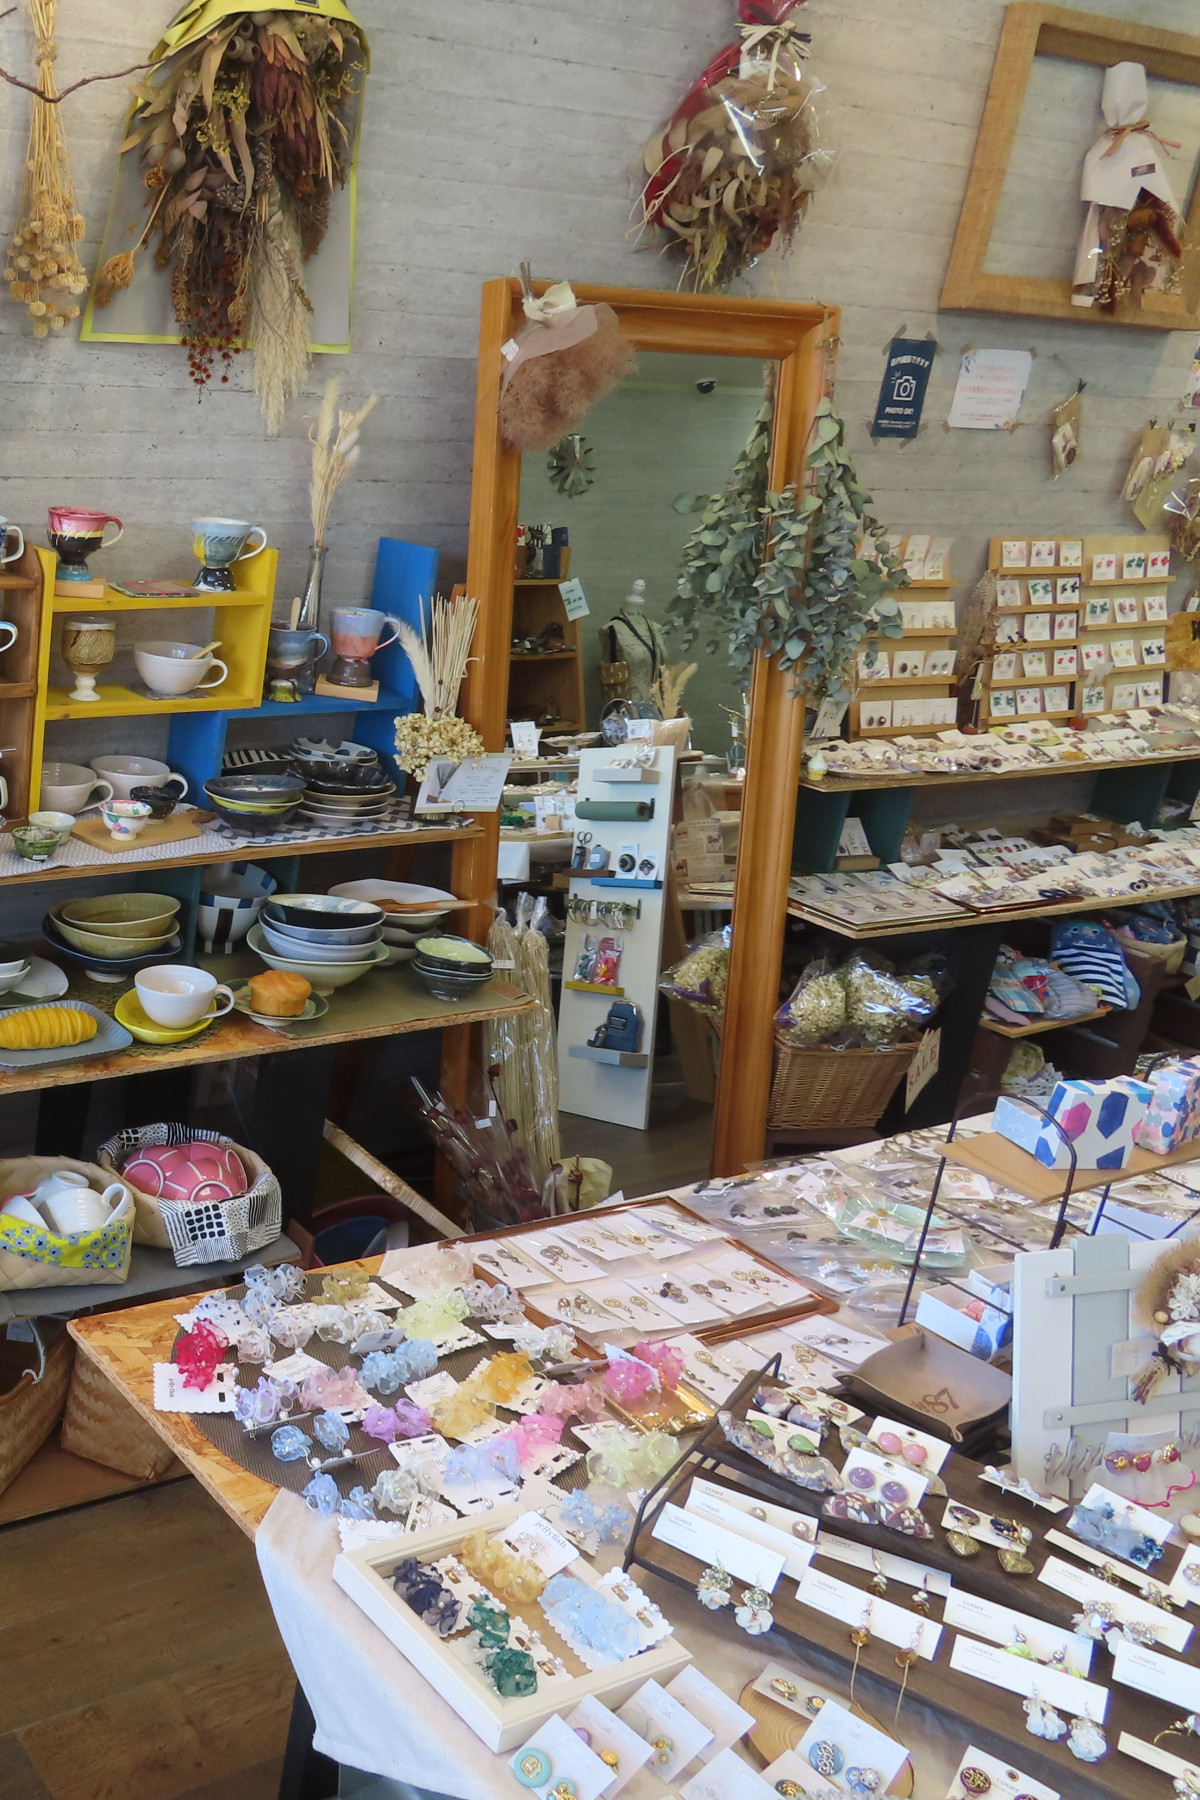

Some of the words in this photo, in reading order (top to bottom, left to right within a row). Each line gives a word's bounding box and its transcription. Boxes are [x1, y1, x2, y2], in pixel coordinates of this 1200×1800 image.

[884, 406, 903, 415] PHOTO
[167, 1377, 176, 1399] jellyfish
[533, 1518, 568, 1550] jellyfish
